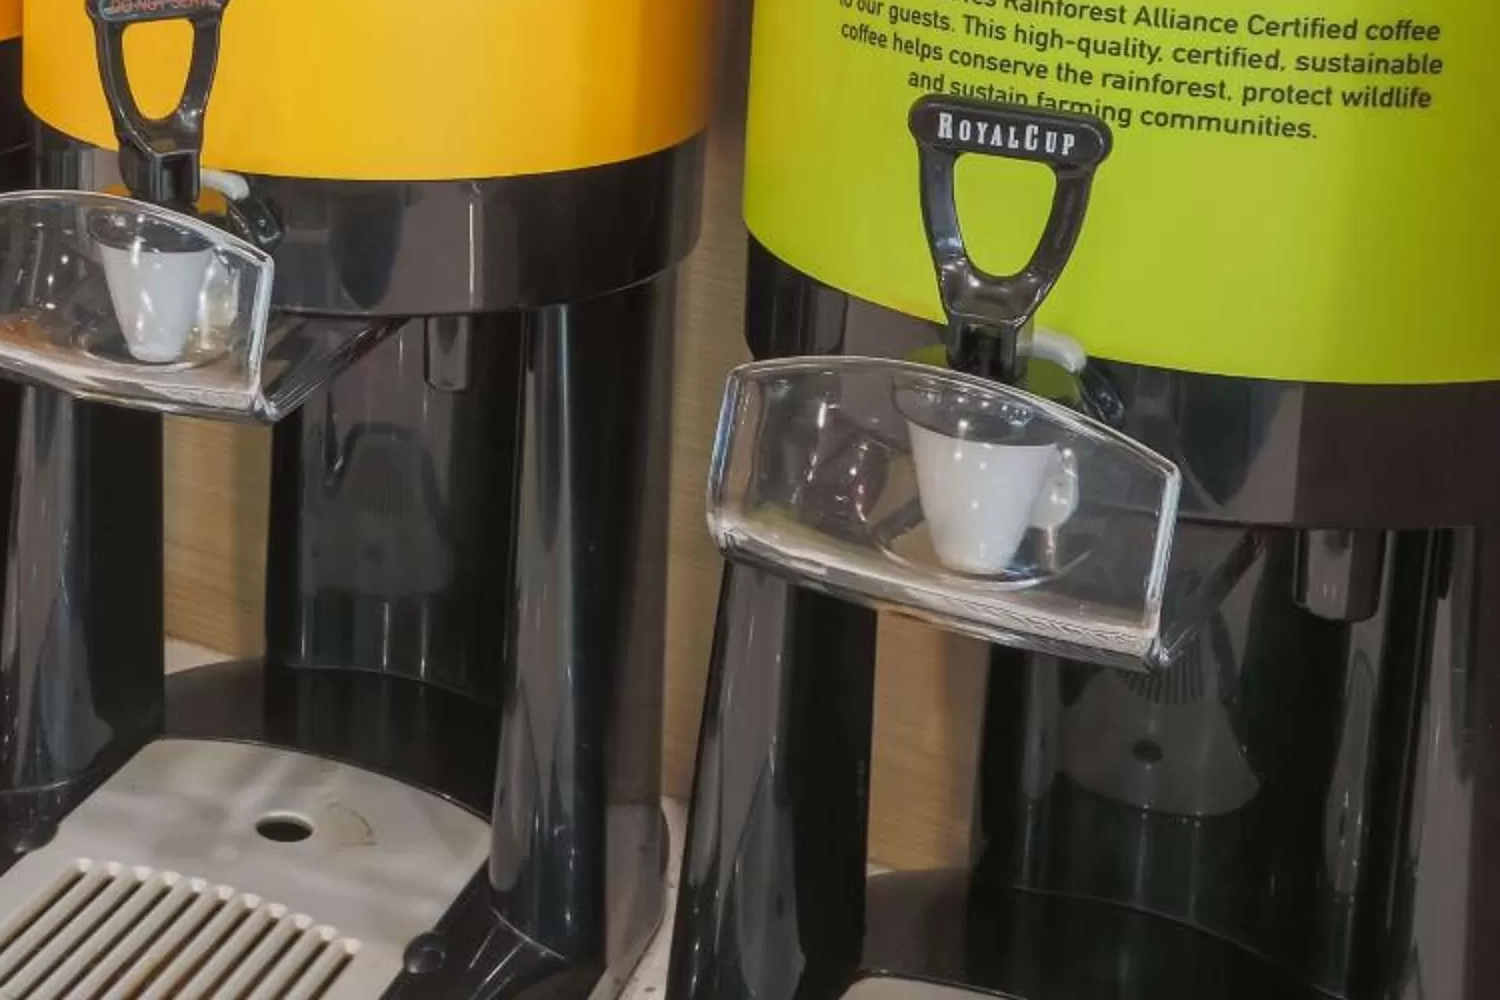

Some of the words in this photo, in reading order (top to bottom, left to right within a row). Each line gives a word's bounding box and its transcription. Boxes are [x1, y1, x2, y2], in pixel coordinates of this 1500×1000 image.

[889, 4, 956, 32] guests.
[963, 13, 1007, 41] This
[1295, 52, 1443, 75] sustainable
[1133, 5, 1238, 34] Alliance
[1247, 14, 1359, 41] Certified
[1365, 19, 1441, 41] coffee
[841, 22, 888, 49] coffee
[893, 32, 943, 63] helps
[949, 49, 1048, 80] conserve
[1056, 62, 1093, 86] the
[1241, 82, 1333, 108] protect
[1341, 85, 1433, 109] wildlife
[907, 71, 944, 92] and
[950, 80, 1029, 105] sustain
[1037, 91, 1132, 128] farming
[1139, 106, 1318, 141] communities.
